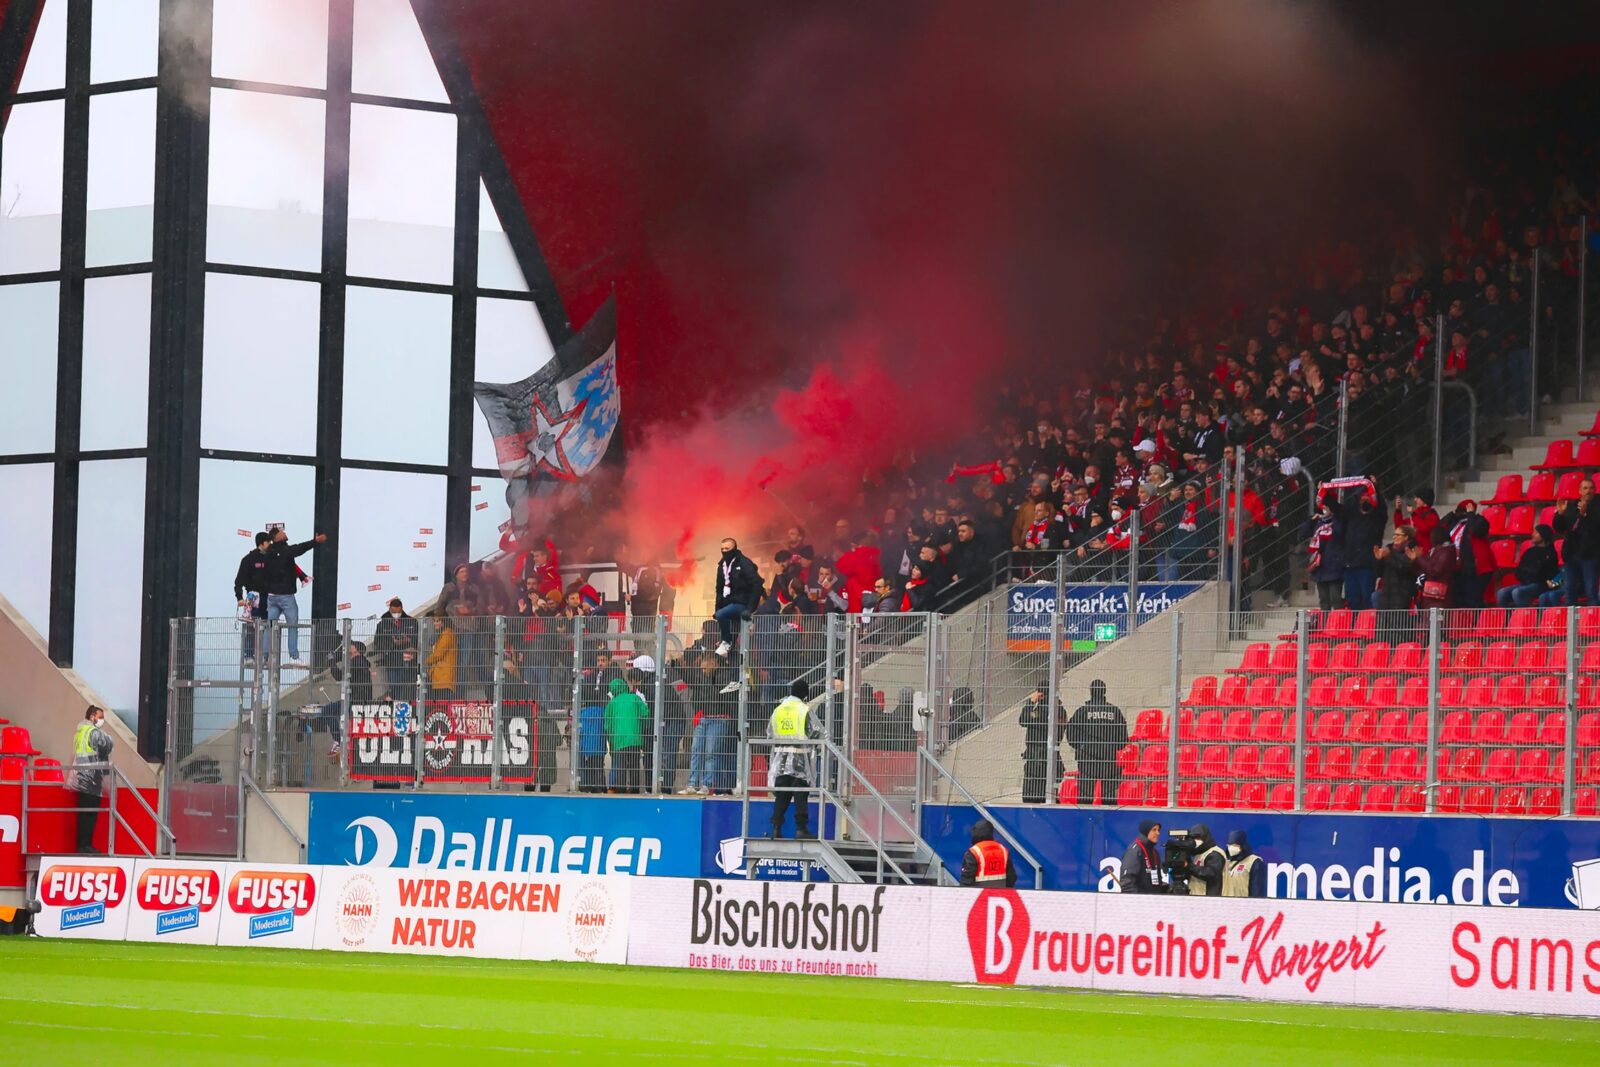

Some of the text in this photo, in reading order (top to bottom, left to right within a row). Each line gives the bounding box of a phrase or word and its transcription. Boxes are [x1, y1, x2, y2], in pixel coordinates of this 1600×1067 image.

[780, 719, 794, 731] 293
[1087, 711, 1115, 720] POLIZEI
[49, 871, 119, 901] FUSSL
[144, 875, 213, 905] FUSSL
[236, 878, 307, 909] FUSSL
[398, 878, 561, 913] WIR BACKEN
[65, 907, 101, 923] Modestraße
[161, 912, 195, 928] Modestraße
[343, 902, 372, 917] HAHN
[575, 912, 606, 927] HAHN
[691, 879, 886, 953] Bischofshof
[253, 915, 290, 931] Modestraße
[391, 917, 476, 949] NATUR
[690, 952, 878, 976] Das Bier, das uns zu Freunden macht
[1450, 921, 1600, 994] Sams
